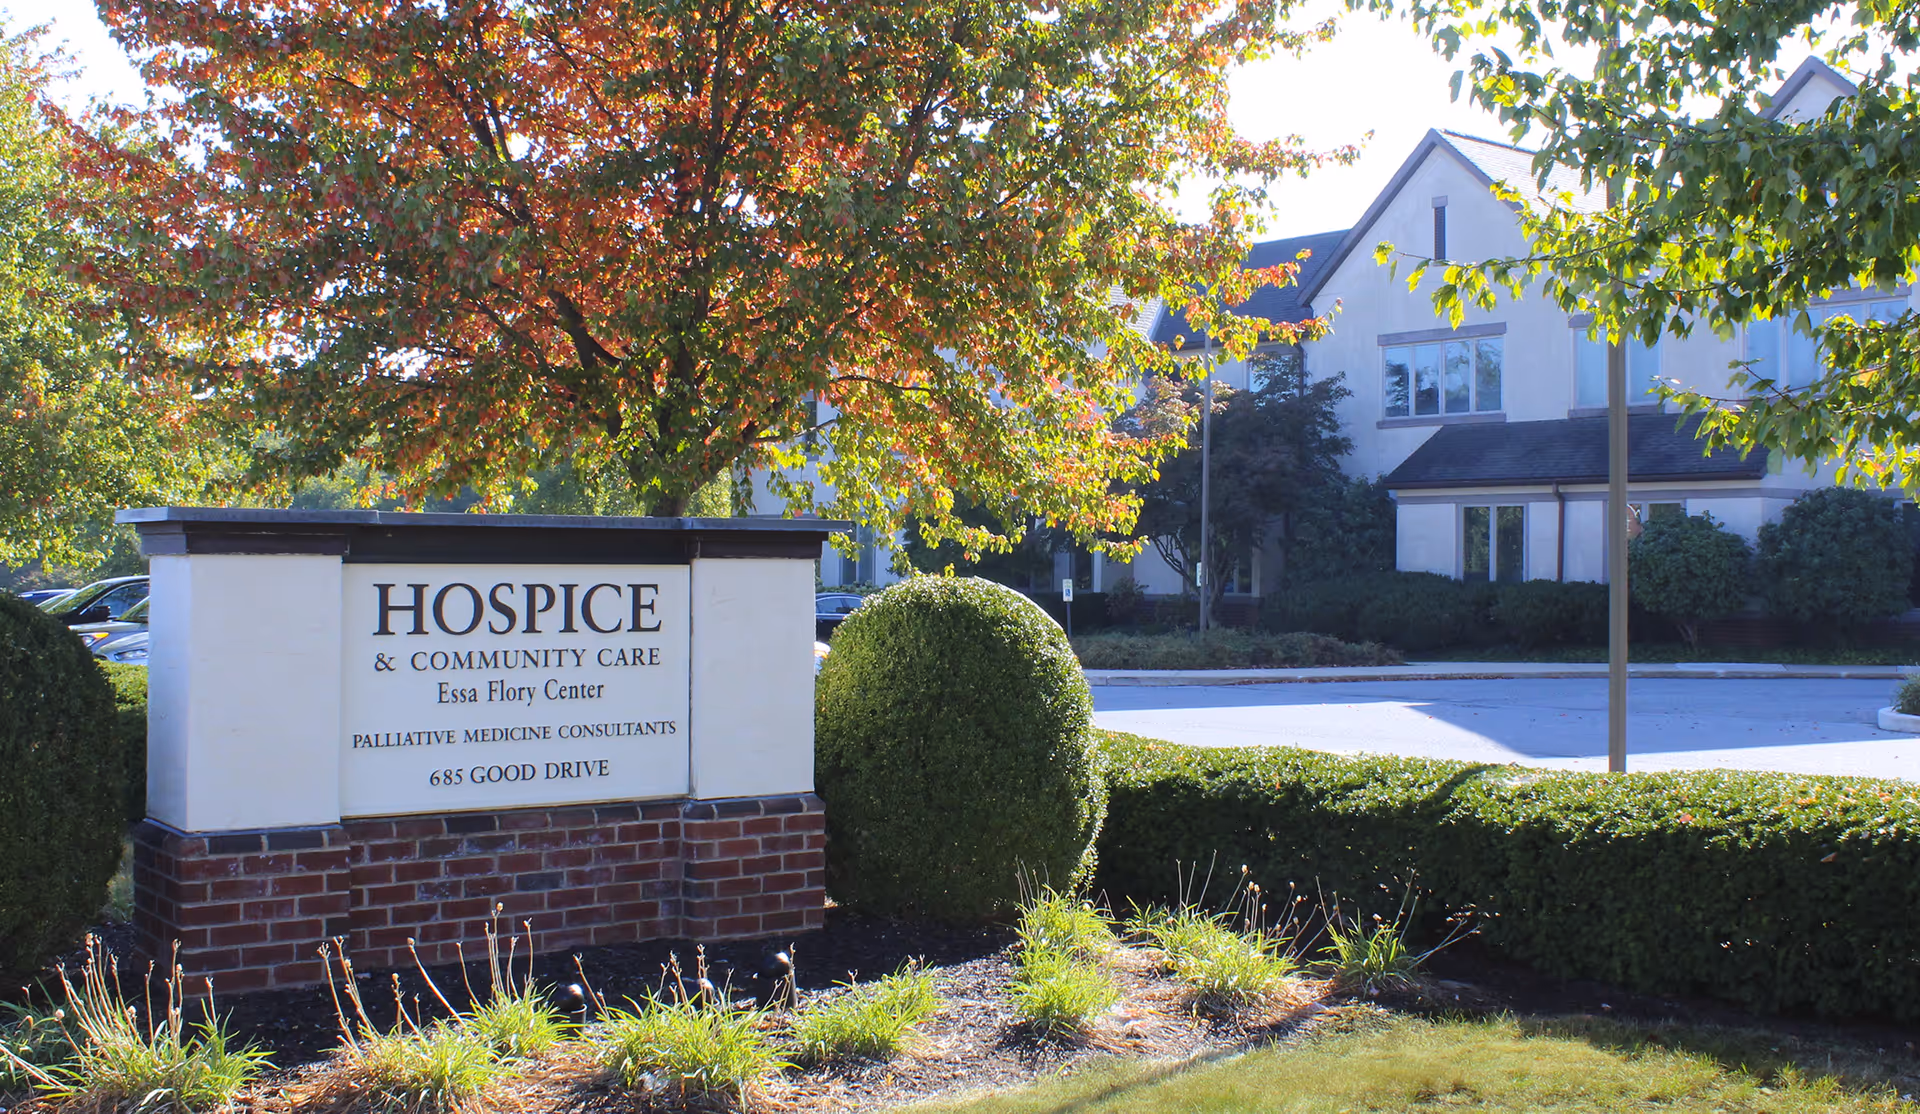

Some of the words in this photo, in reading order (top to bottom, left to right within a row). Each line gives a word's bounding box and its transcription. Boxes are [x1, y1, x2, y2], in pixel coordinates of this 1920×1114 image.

[372, 582, 662, 637] HOSPICE
[374, 652, 396, 672] &
[410, 648, 587, 672] COMMUNITY
[597, 647, 661, 667] CARE
[437, 681, 478, 704] Essa
[487, 679, 536, 707] Flory
[543, 678, 605, 701] Center
[352, 729, 456, 749] PALLIATIVE
[463, 725, 552, 744] MEDICINE
[557, 720, 677, 739] CONSULTANTS
[429, 768, 464, 787] 685
[469, 763, 537, 784] GOOD
[544, 759, 610, 780] DRIVE
